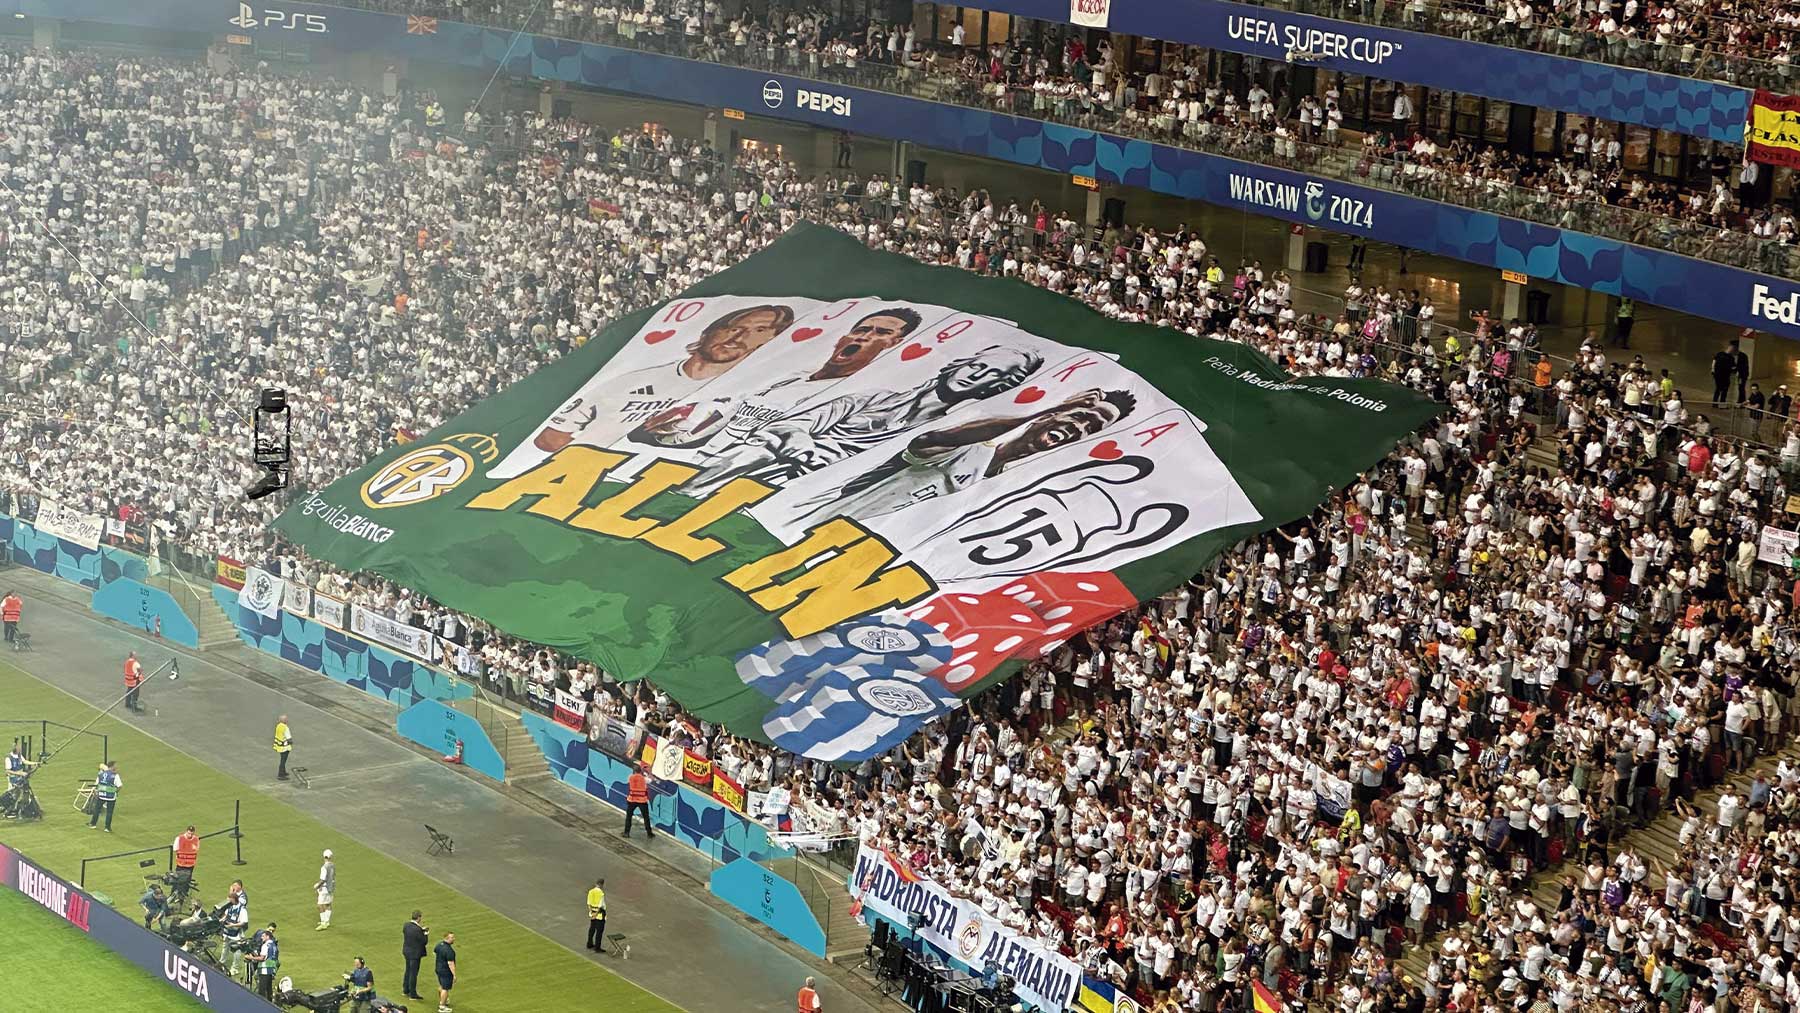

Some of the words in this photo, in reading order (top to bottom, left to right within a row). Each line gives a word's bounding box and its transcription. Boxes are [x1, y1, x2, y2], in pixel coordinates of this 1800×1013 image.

[264, 9, 327, 32] PS5
[1228, 16, 1279, 46] UEFA
[1284, 25, 1349, 60] SUPER
[797, 89, 851, 117] PEPSI
[1229, 173, 1300, 213] WARSAW
[1329, 195, 1373, 229] 2024
[663, 301, 705, 323] 10
[822, 301, 859, 321] J
[936, 319, 974, 343] Q
[1053, 357, 1099, 382] K
[1202, 356, 1238, 376] Peña
[1308, 385, 1329, 395] de
[1328, 387, 1387, 412] Polonia
[1135, 422, 1180, 447] A
[465, 444, 783, 566] ALL
[717, 514, 939, 640] IN
[959, 507, 1062, 565] 15
[18, 860, 68, 919] WELCOME
[66, 891, 90, 933] ALL
[854, 855, 958, 940] MADRIDISTA
[164, 950, 209, 1003] UEFA
